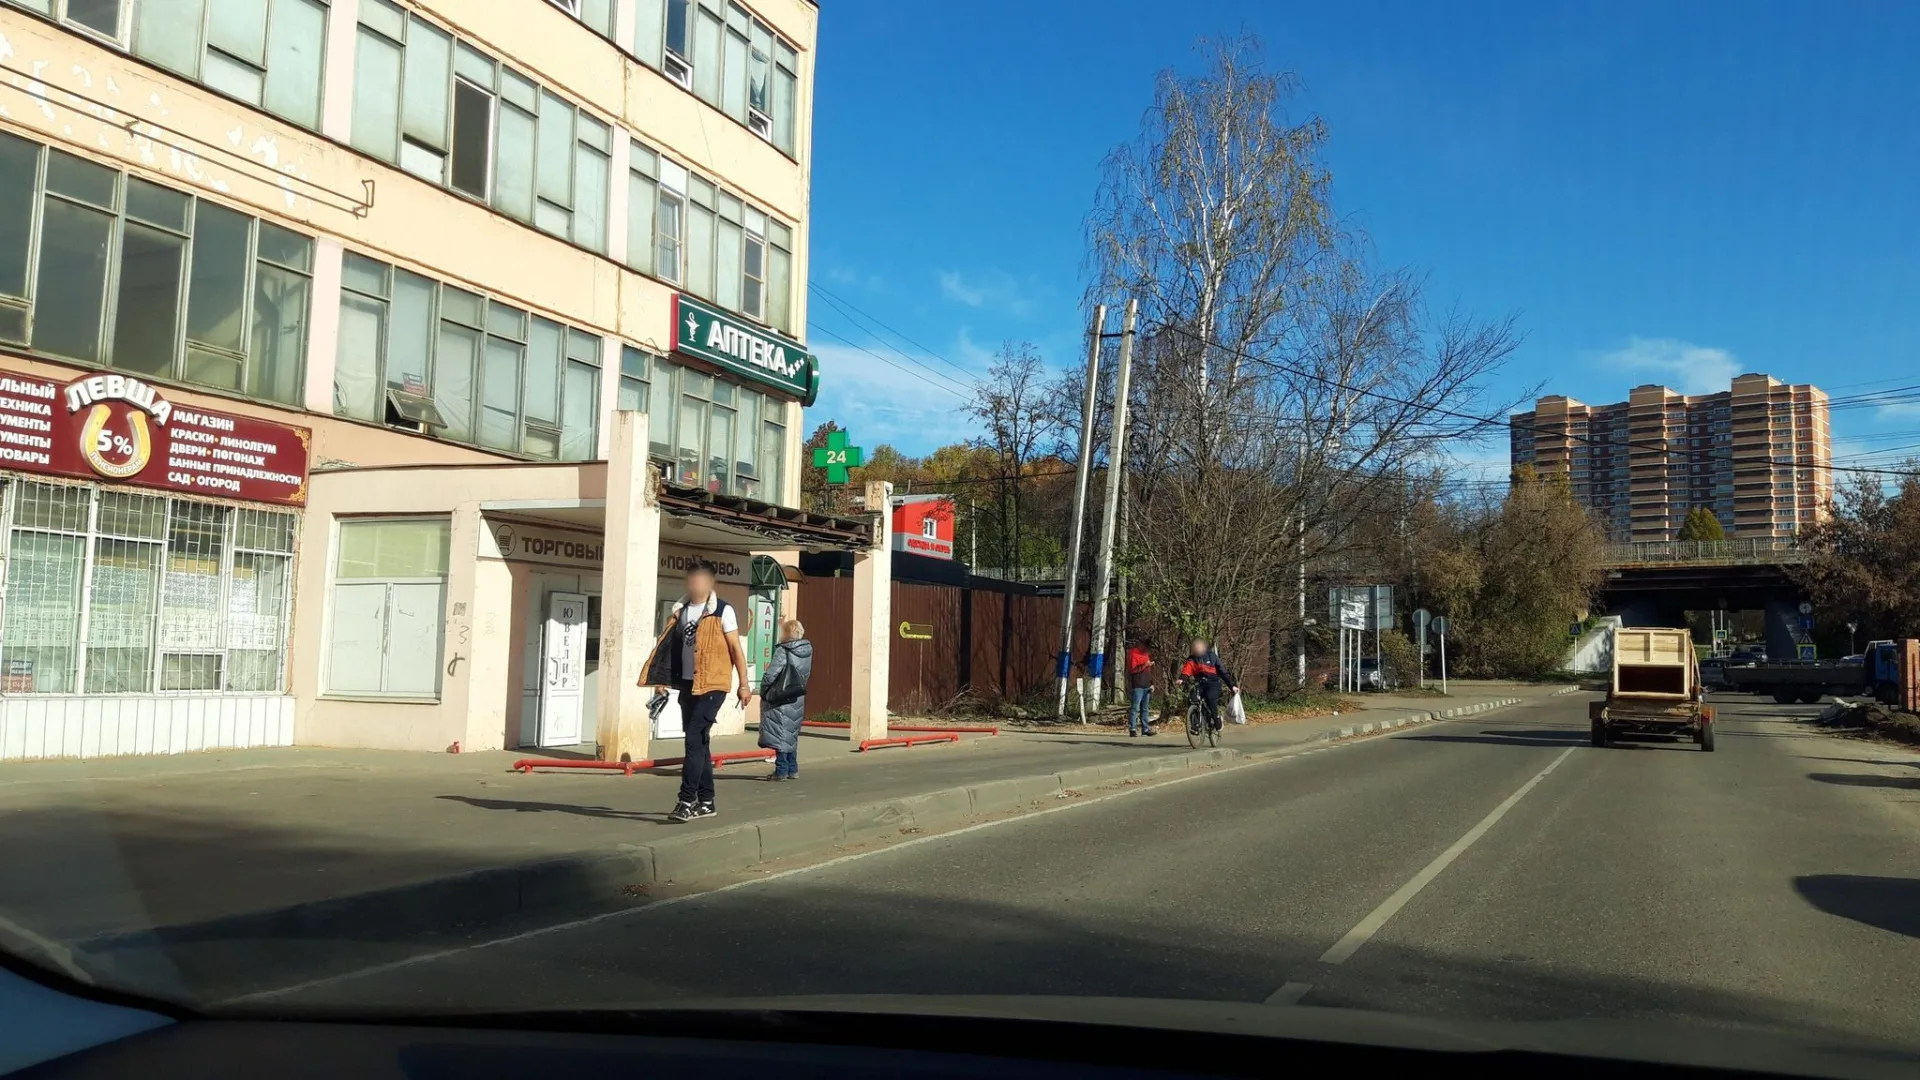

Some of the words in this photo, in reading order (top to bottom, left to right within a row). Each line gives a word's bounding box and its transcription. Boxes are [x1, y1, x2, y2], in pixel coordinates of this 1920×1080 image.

[706, 320, 788, 376] АПТЕКА
[0, 378, 56, 399] ЛЬНЫЙ
[64, 375, 172, 427] ЛЕВША
[173, 410, 235, 431] МАГАЗИН
[97, 429, 133, 455] 5%
[170, 427, 214, 444] КРАСКИ
[219, 436, 277, 454] ЛИНОЛЕУМ
[169, 442, 206, 457] ДВЕРИ
[212, 448, 265, 467] ПОГОНАЖ
[826, 450, 847, 464] 24
[168, 457, 211, 472] БАННЫЕ
[212, 463, 302, 485] ПРИНАДЛЕЖНОСТИ
[168, 471, 191, 486] САД
[196, 475, 241, 492] ОГОРОД
